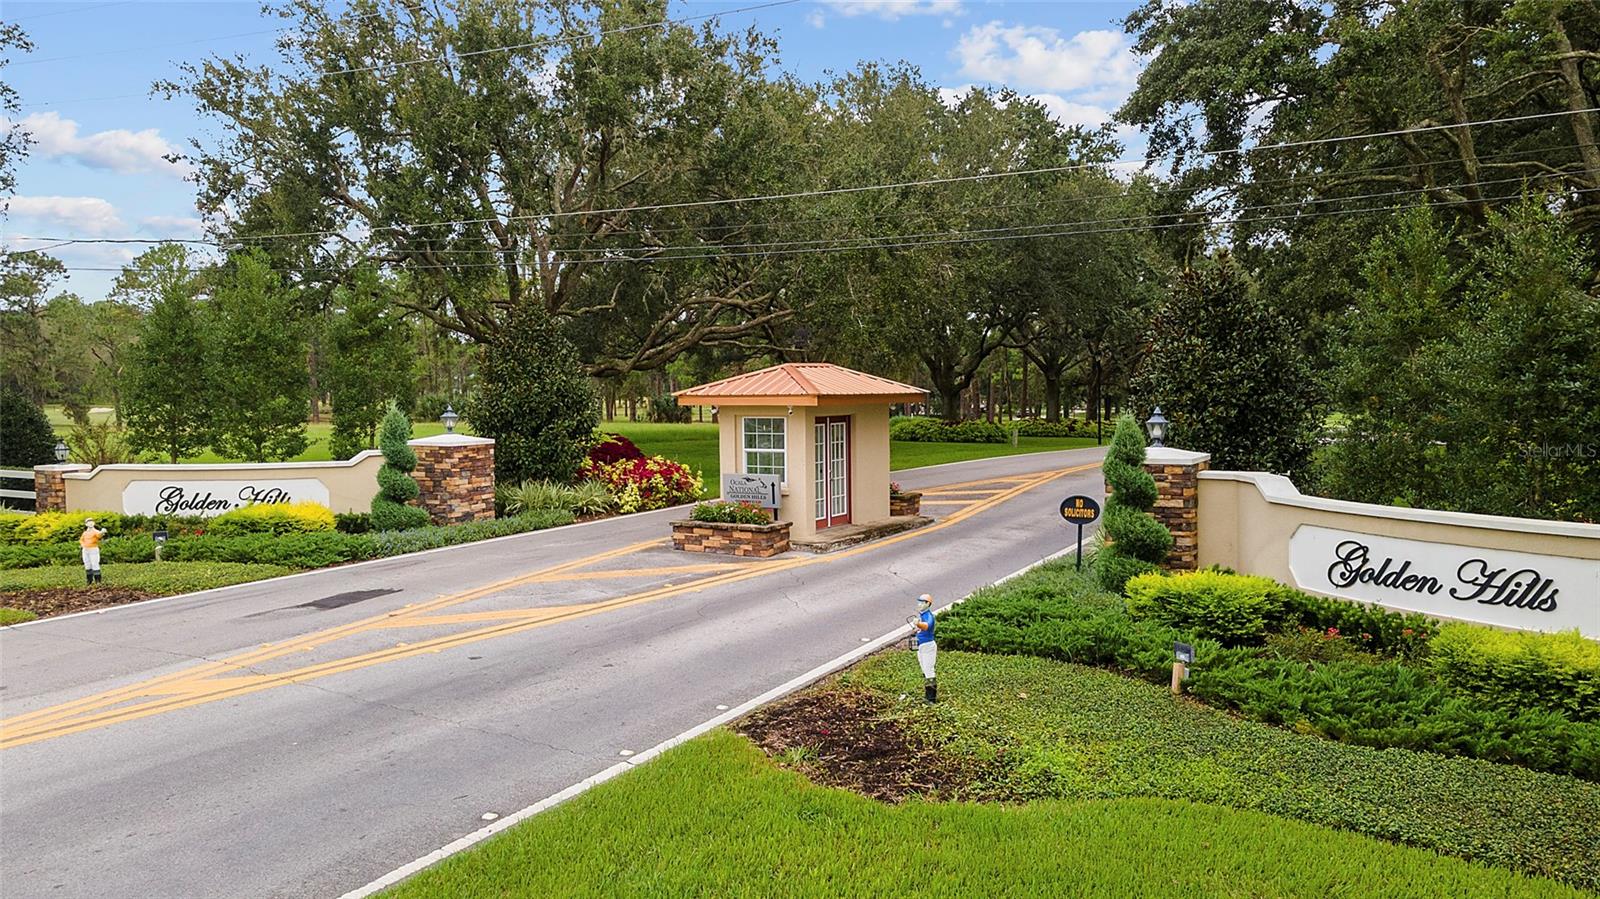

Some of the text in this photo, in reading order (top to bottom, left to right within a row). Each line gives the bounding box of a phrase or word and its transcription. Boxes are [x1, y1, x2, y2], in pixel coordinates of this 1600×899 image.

[155, 486, 231, 515] Golden
[1075, 498, 1084, 508] NO
[1064, 507, 1095, 518] SOLICITORS
[1327, 540, 1559, 612] Golden Hills
